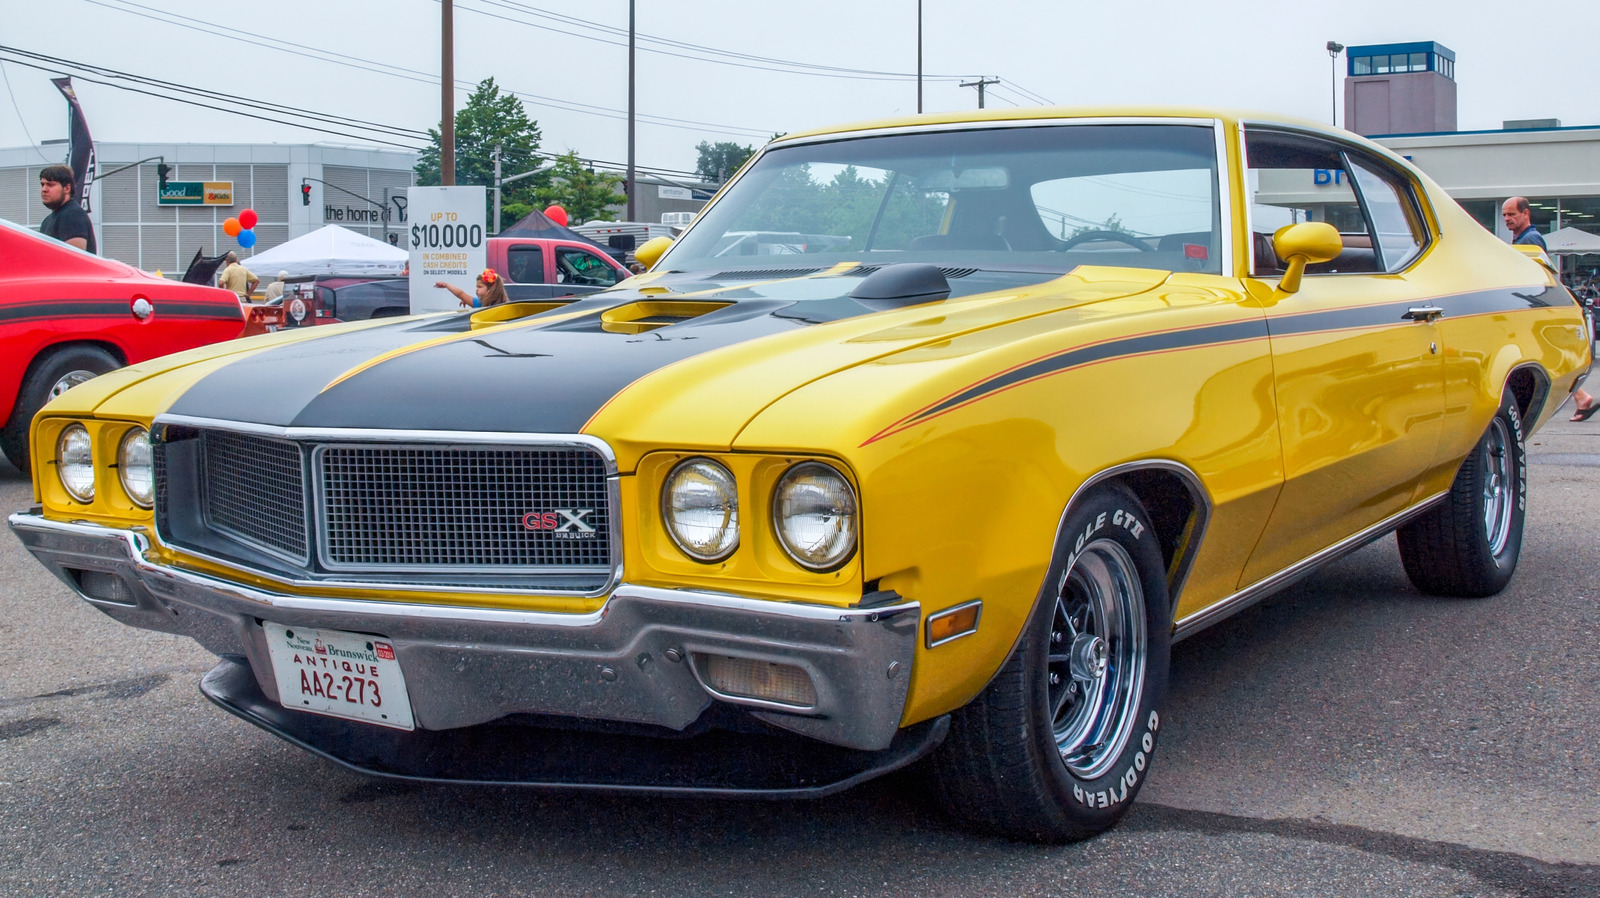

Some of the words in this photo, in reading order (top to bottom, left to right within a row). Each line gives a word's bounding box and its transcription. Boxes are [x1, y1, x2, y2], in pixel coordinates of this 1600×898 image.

[325, 205, 343, 220] the
[347, 205, 378, 222] home
[431, 212, 443, 221] UP
[445, 212, 457, 221] TO
[412, 223, 481, 250] $10,000
[1508, 405, 1526, 511] GOODYEAR
[522, 509, 596, 532] GSX
[327, 644, 379, 662] Brunswick
[293, 654, 379, 677] ANTIQUE
[301, 668, 382, 707] AA2-273
[1073, 710, 1159, 809] GOODYEAR
